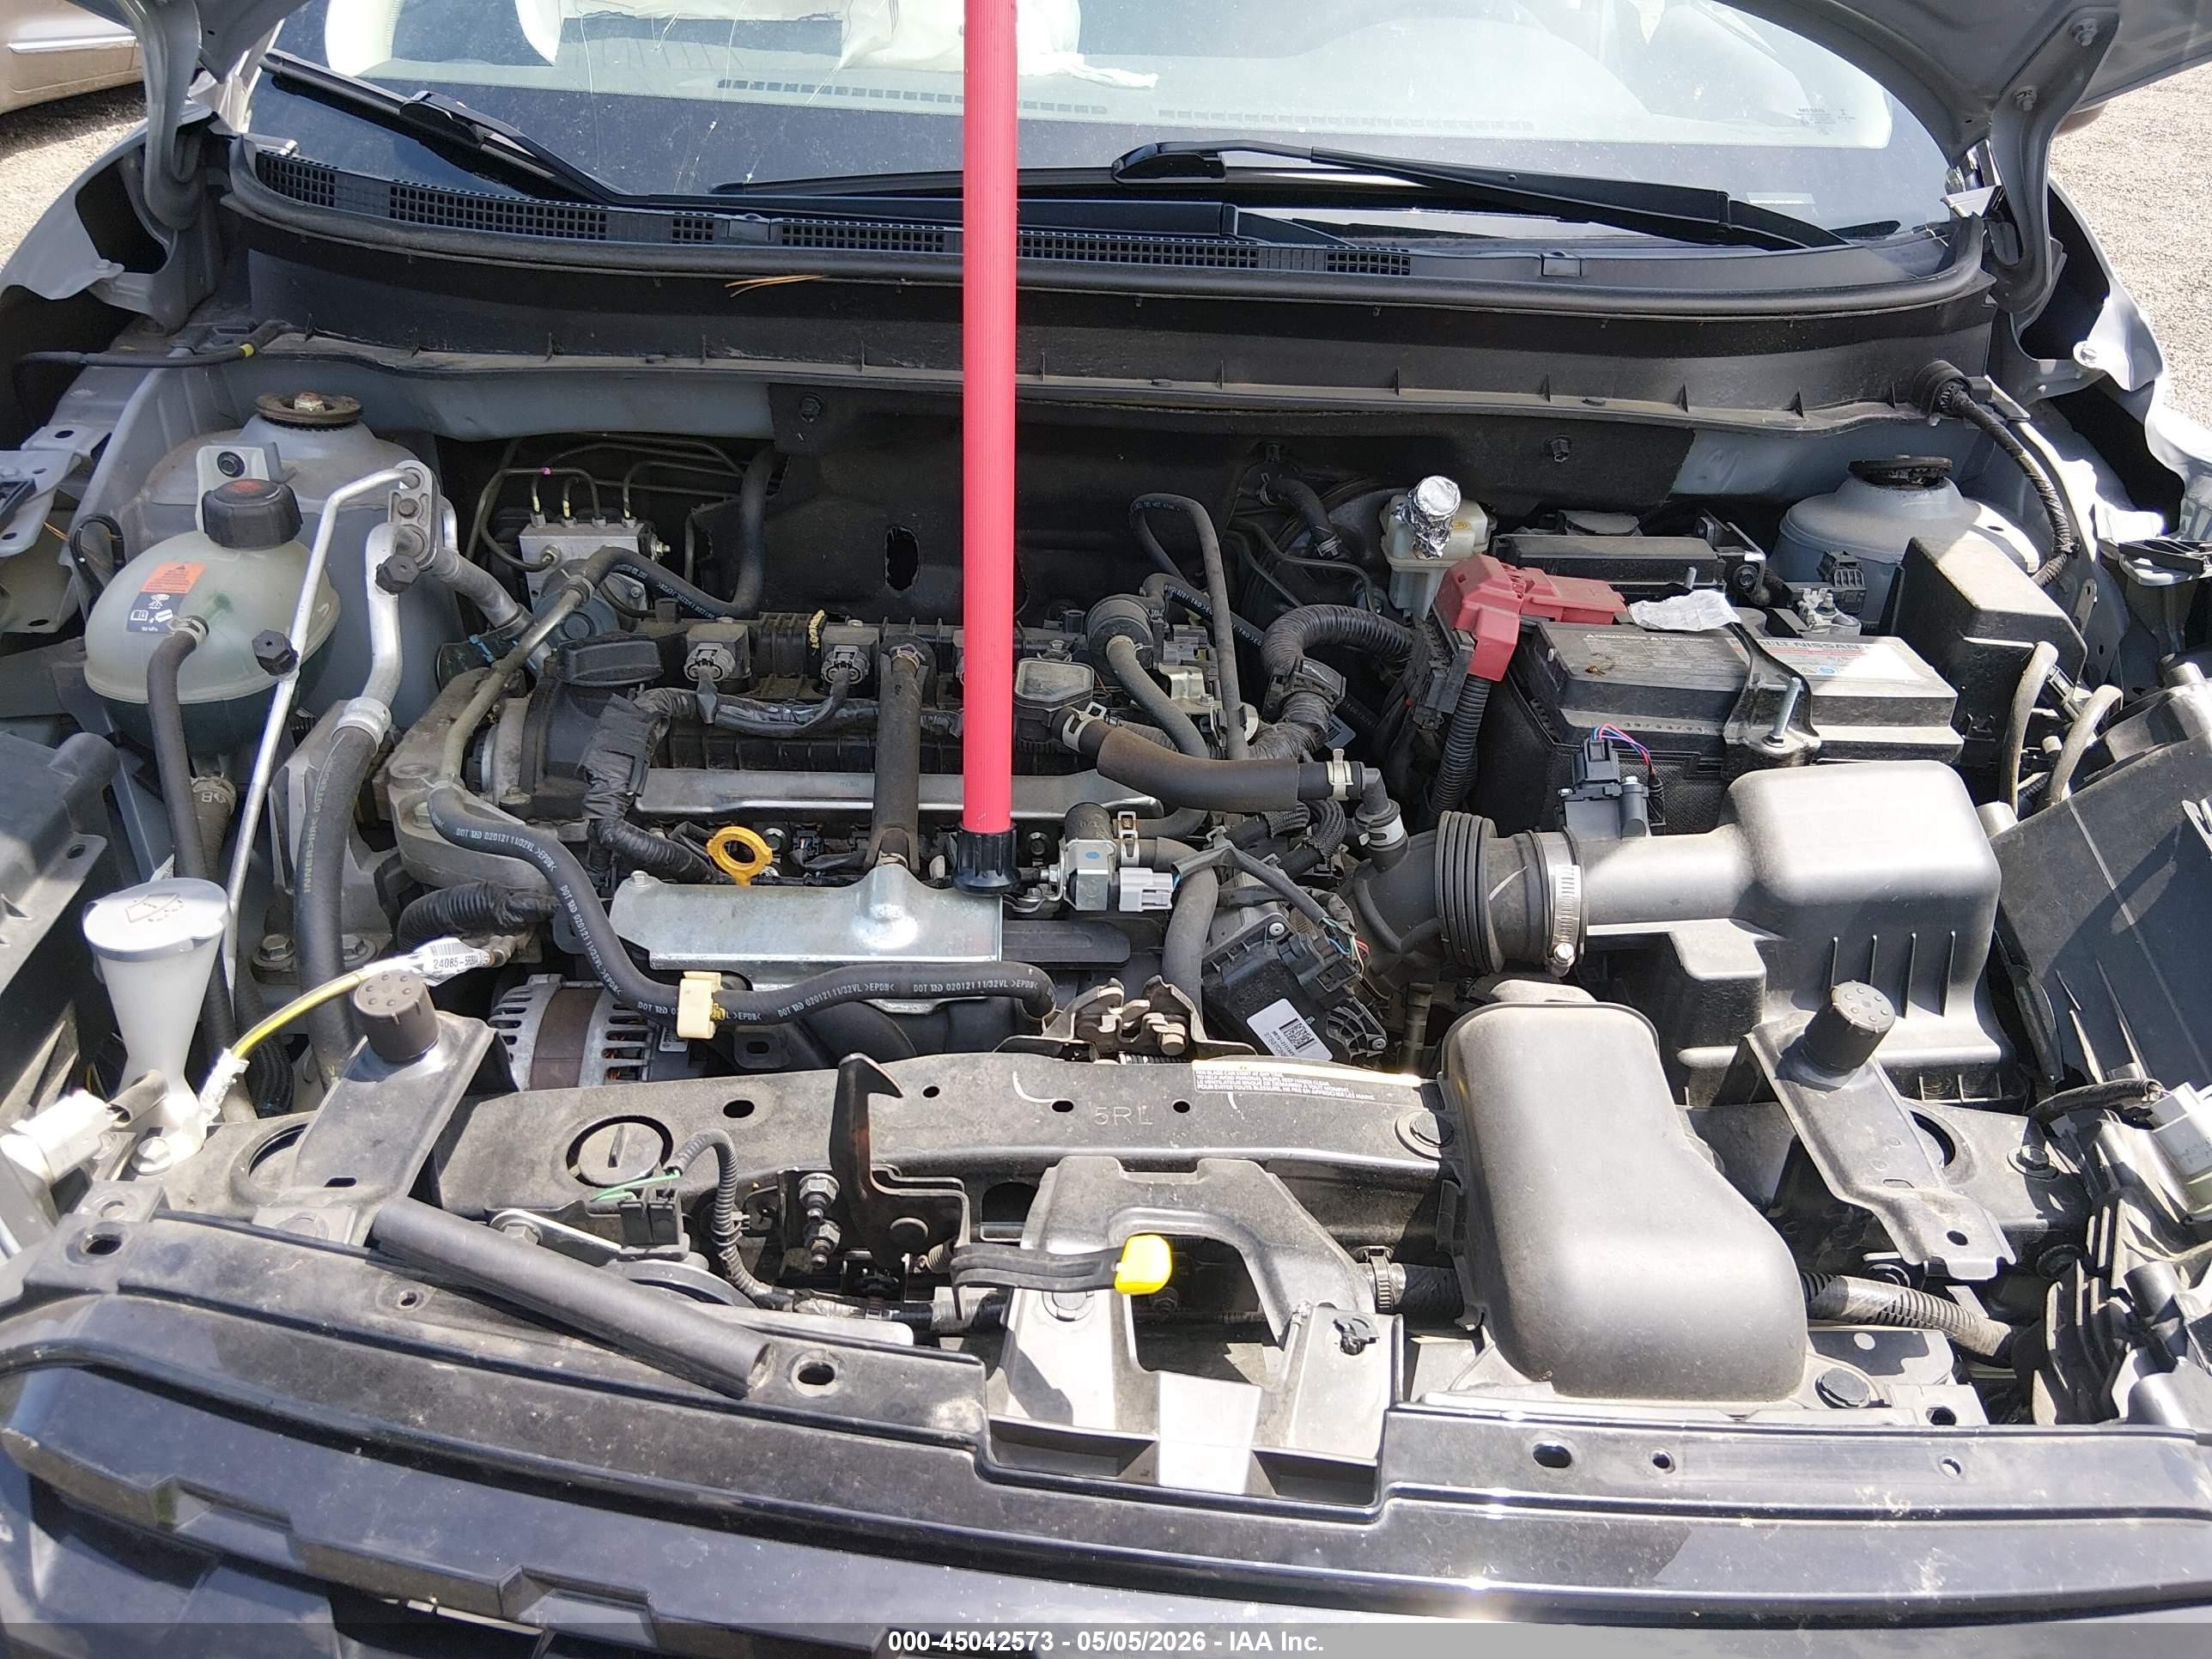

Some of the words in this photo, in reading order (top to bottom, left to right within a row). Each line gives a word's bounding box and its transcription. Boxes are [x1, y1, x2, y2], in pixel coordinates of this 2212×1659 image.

[1793, 641, 1861, 650] NISSAN
[456, 827, 470, 838] DOT
[560, 884, 573, 900] DOT
[913, 983, 927, 994] DOT
[945, 981, 975, 992] 020121
[637, 1000, 653, 1012] DOT
[777, 1006, 792, 1018] DOT
[805, 990, 831, 1007] 020121
[1094, 1106, 1154, 1126] 5RL
